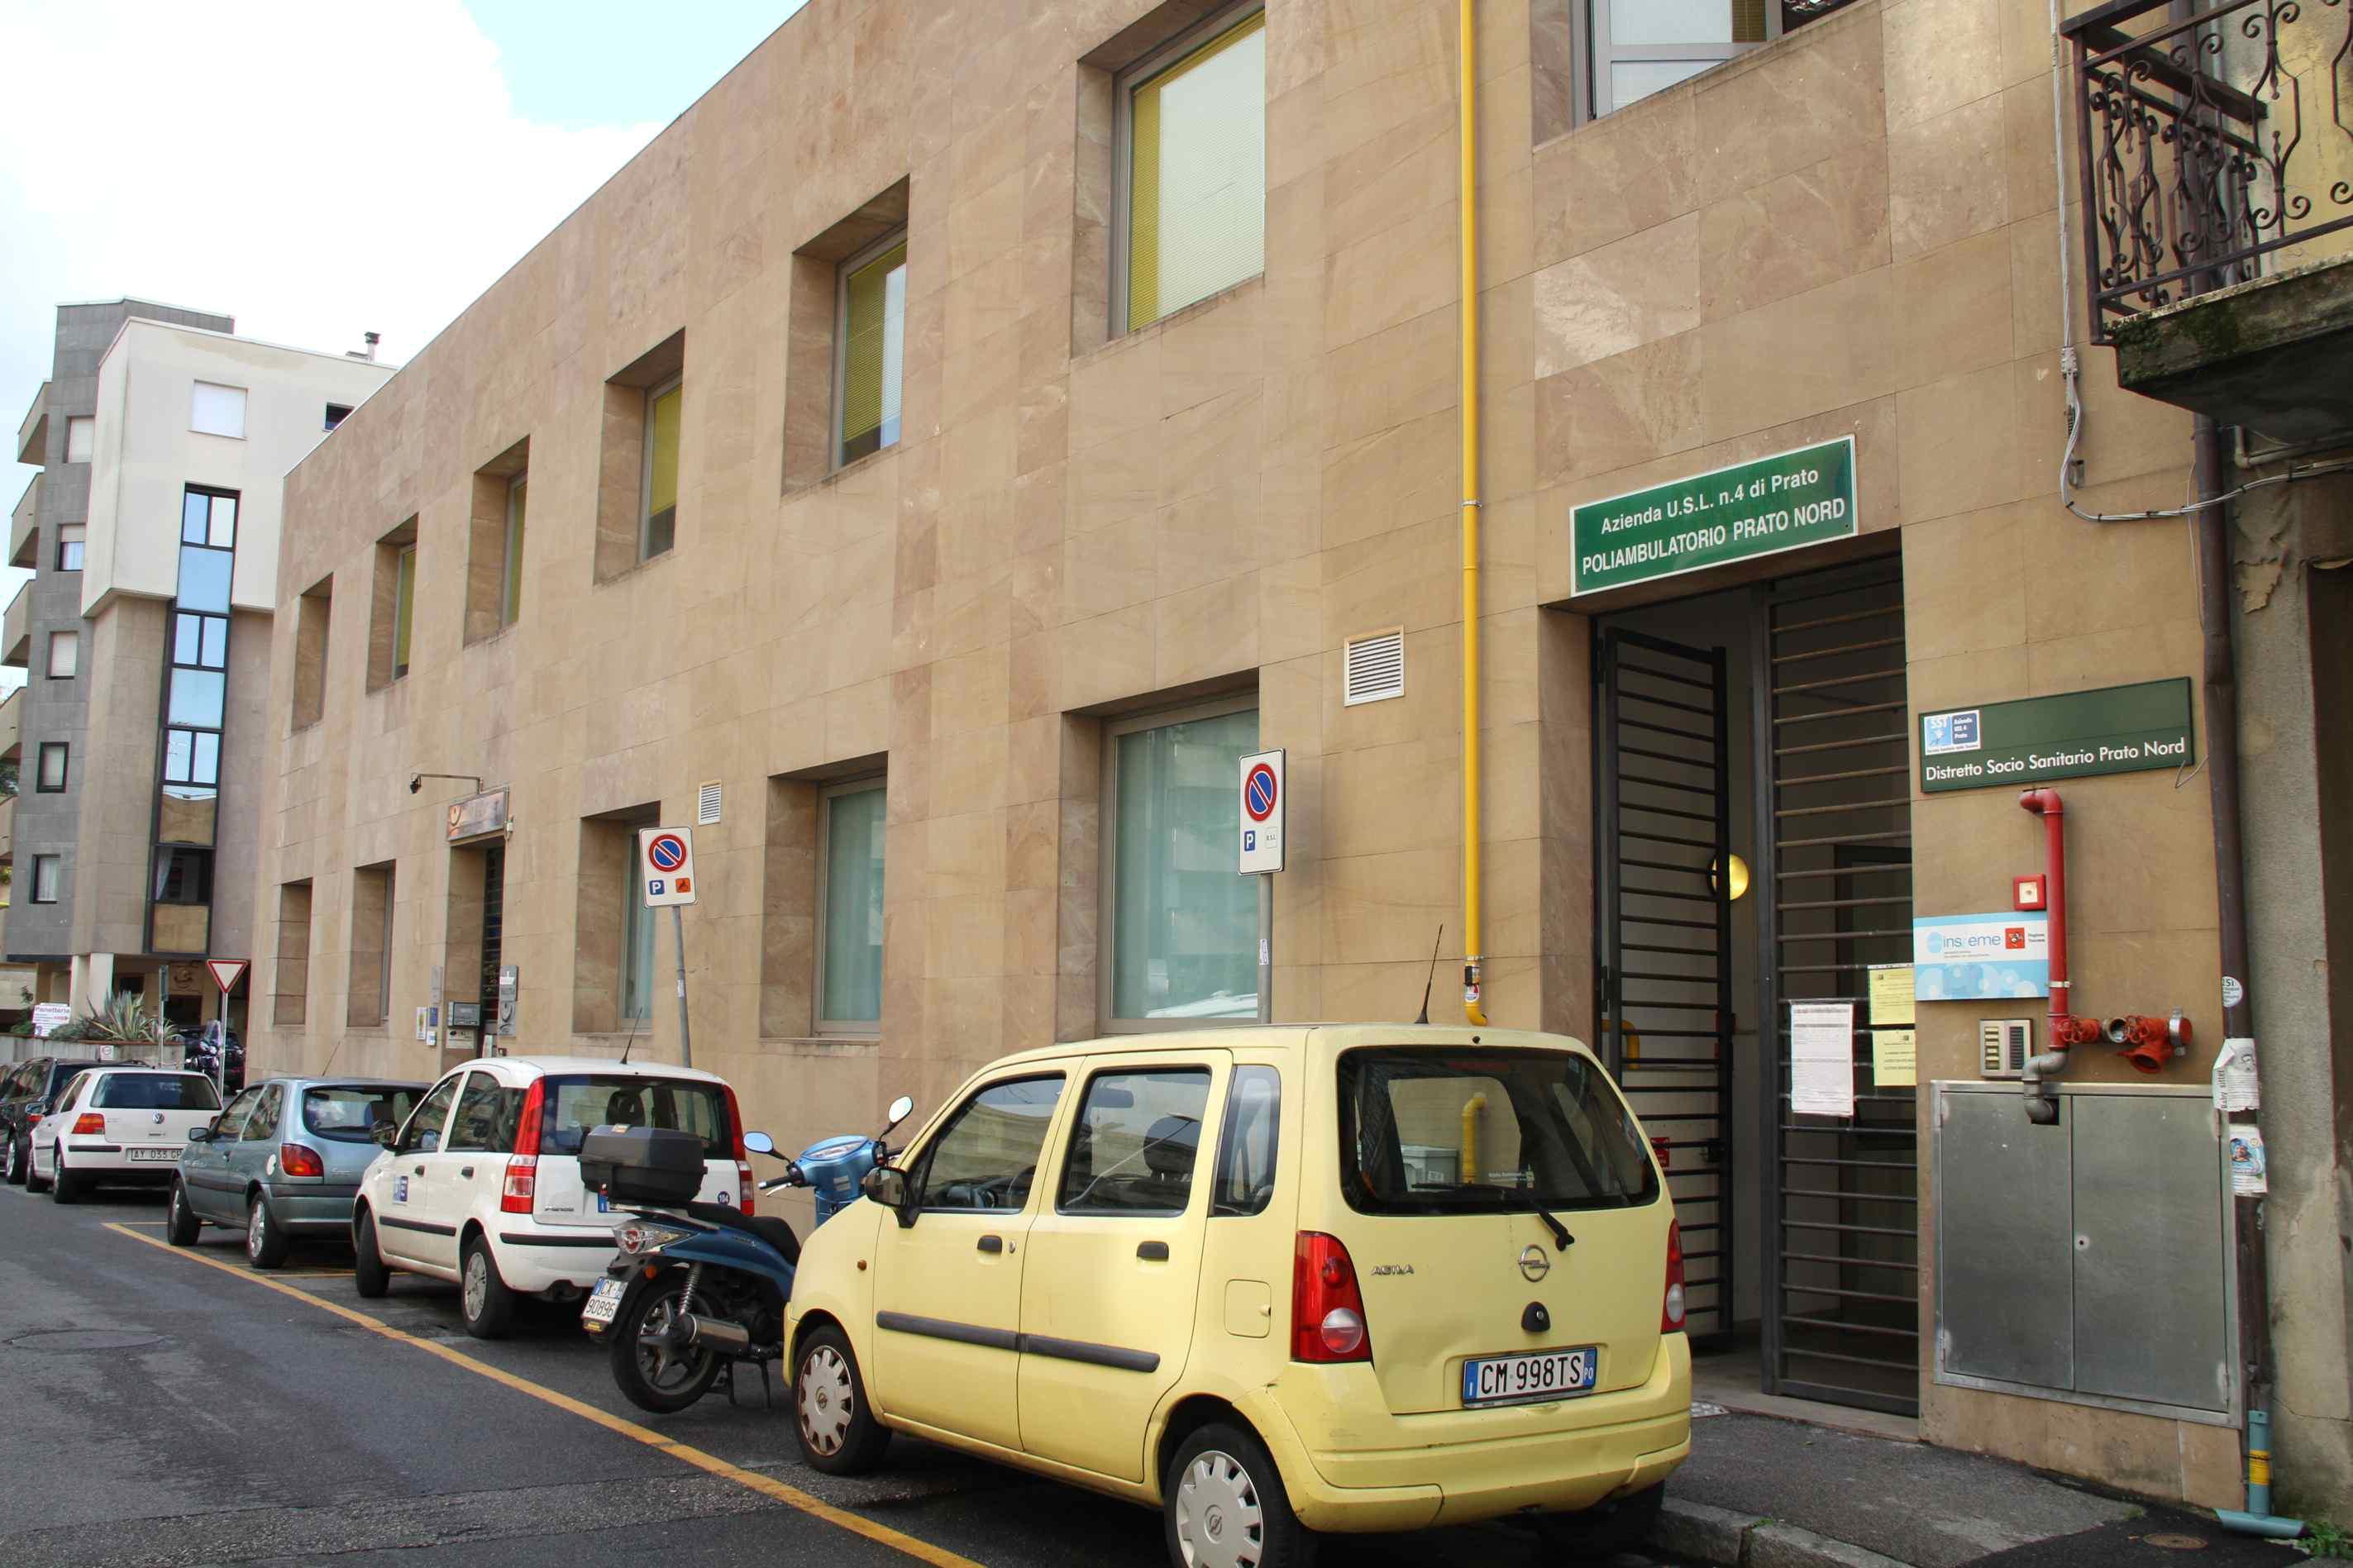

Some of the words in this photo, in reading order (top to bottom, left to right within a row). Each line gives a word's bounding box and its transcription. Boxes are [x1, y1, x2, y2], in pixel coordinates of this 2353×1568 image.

[1601, 508, 1663, 534] Azienda
[1667, 493, 1714, 522] U.S.L.
[1719, 484, 1744, 507] n.4
[1749, 477, 1765, 498] di
[1772, 469, 1819, 493] Prato
[1582, 525, 1725, 575] POLIAMBULATORIO
[1733, 511, 1789, 541] PRATO
[1794, 498, 1845, 527] NORD
[1926, 763, 1983, 781] Distretto
[1987, 756, 2024, 774] Socio
[2029, 750, 2094, 770] Sanitario
[2099, 744, 2139, 762] Prato
[2144, 737, 2185, 757] Nord
[1247, 833, 1254, 850] P
[651, 881, 661, 894] P
[1943, 935, 2002, 948] inseme
[1481, 1362, 1508, 1394] CM
